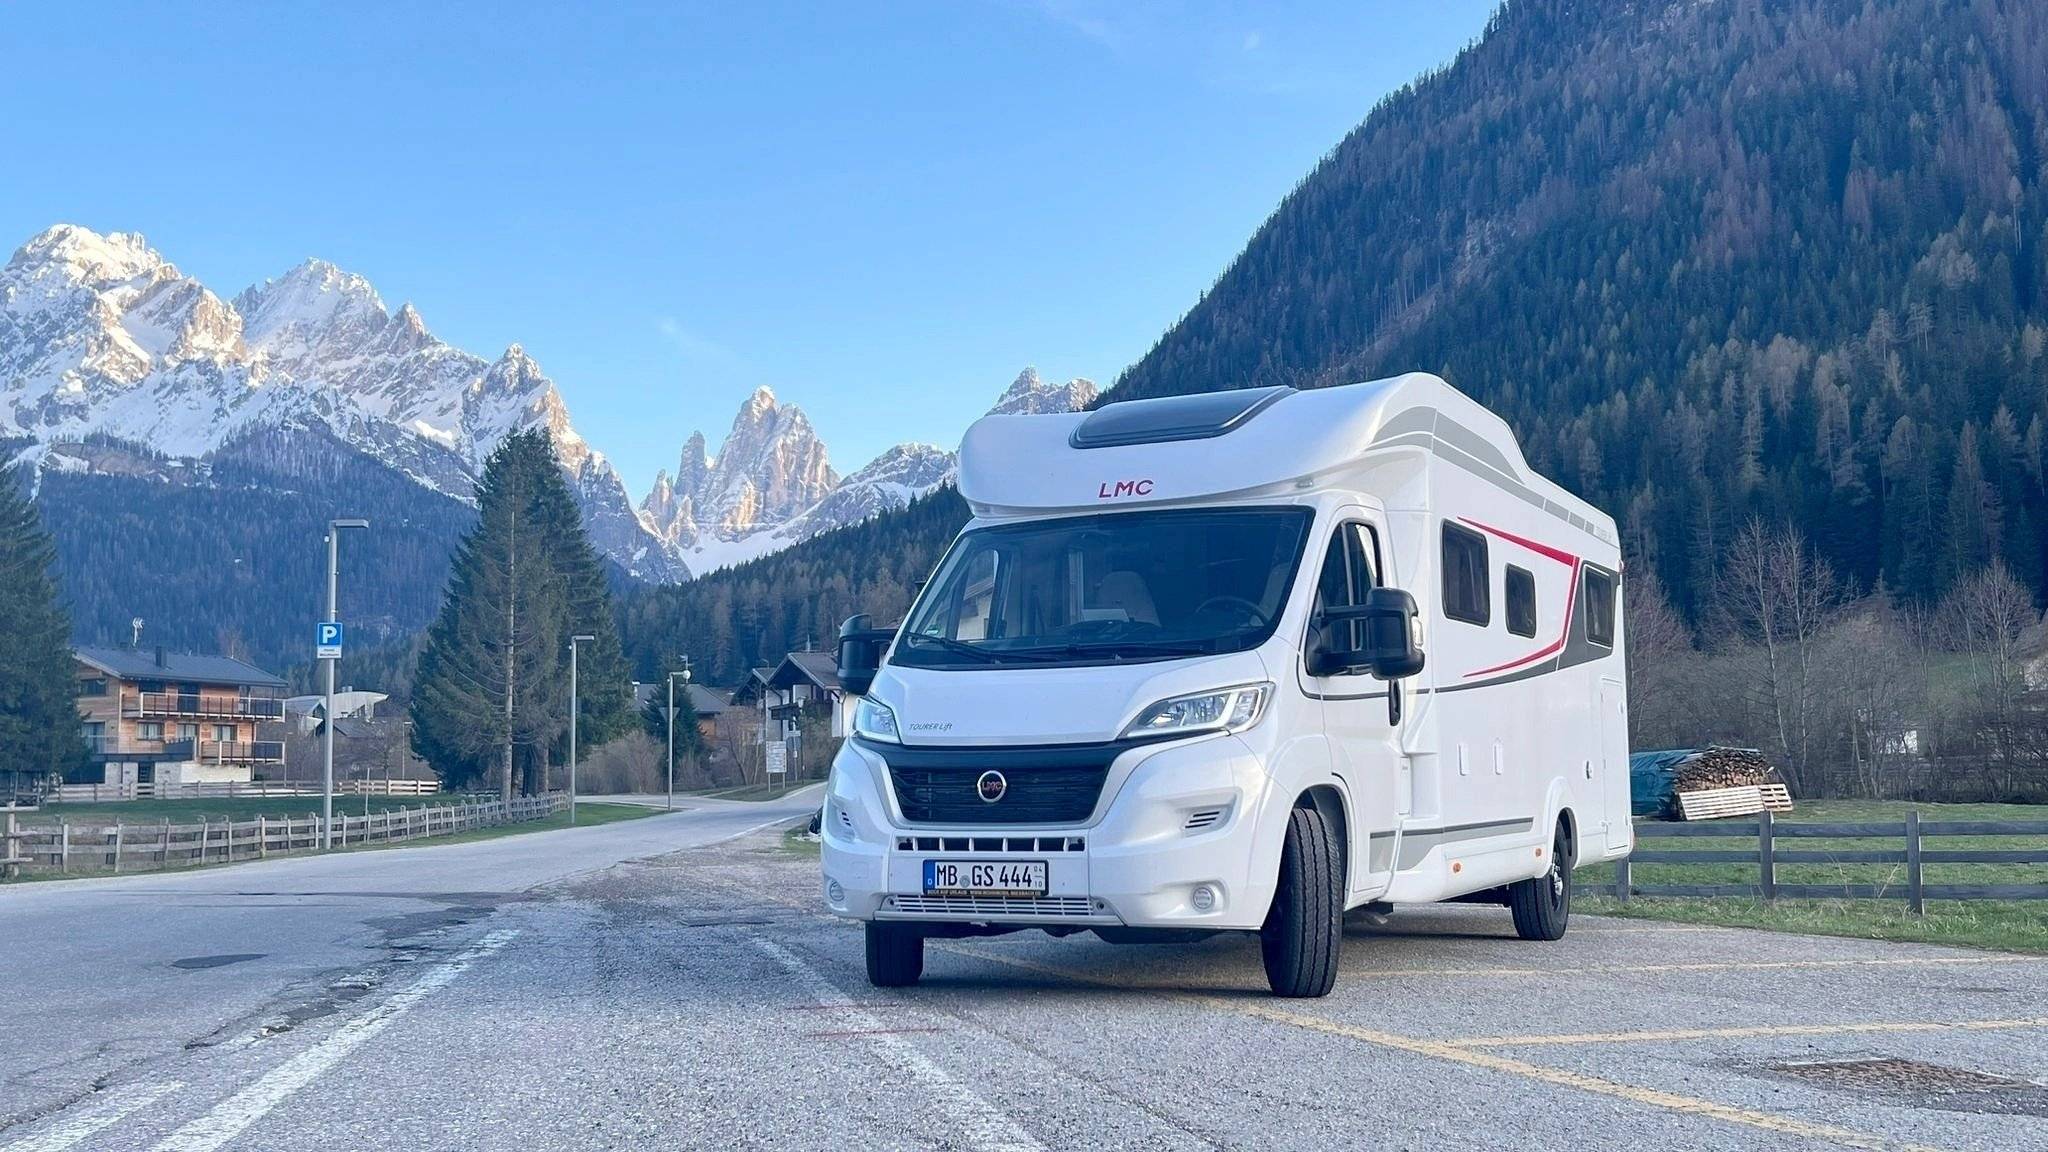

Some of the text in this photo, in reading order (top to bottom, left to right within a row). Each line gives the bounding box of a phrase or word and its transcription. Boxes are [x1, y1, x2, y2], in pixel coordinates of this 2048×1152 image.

[1098, 480, 1154, 498] LMC
[323, 626, 337, 643] P
[909, 722, 939, 730] TOURER
[982, 780, 1002, 791] LMC
[936, 865, 958, 886] MB
[972, 865, 994, 887] GS
[999, 865, 1032, 887] 444
